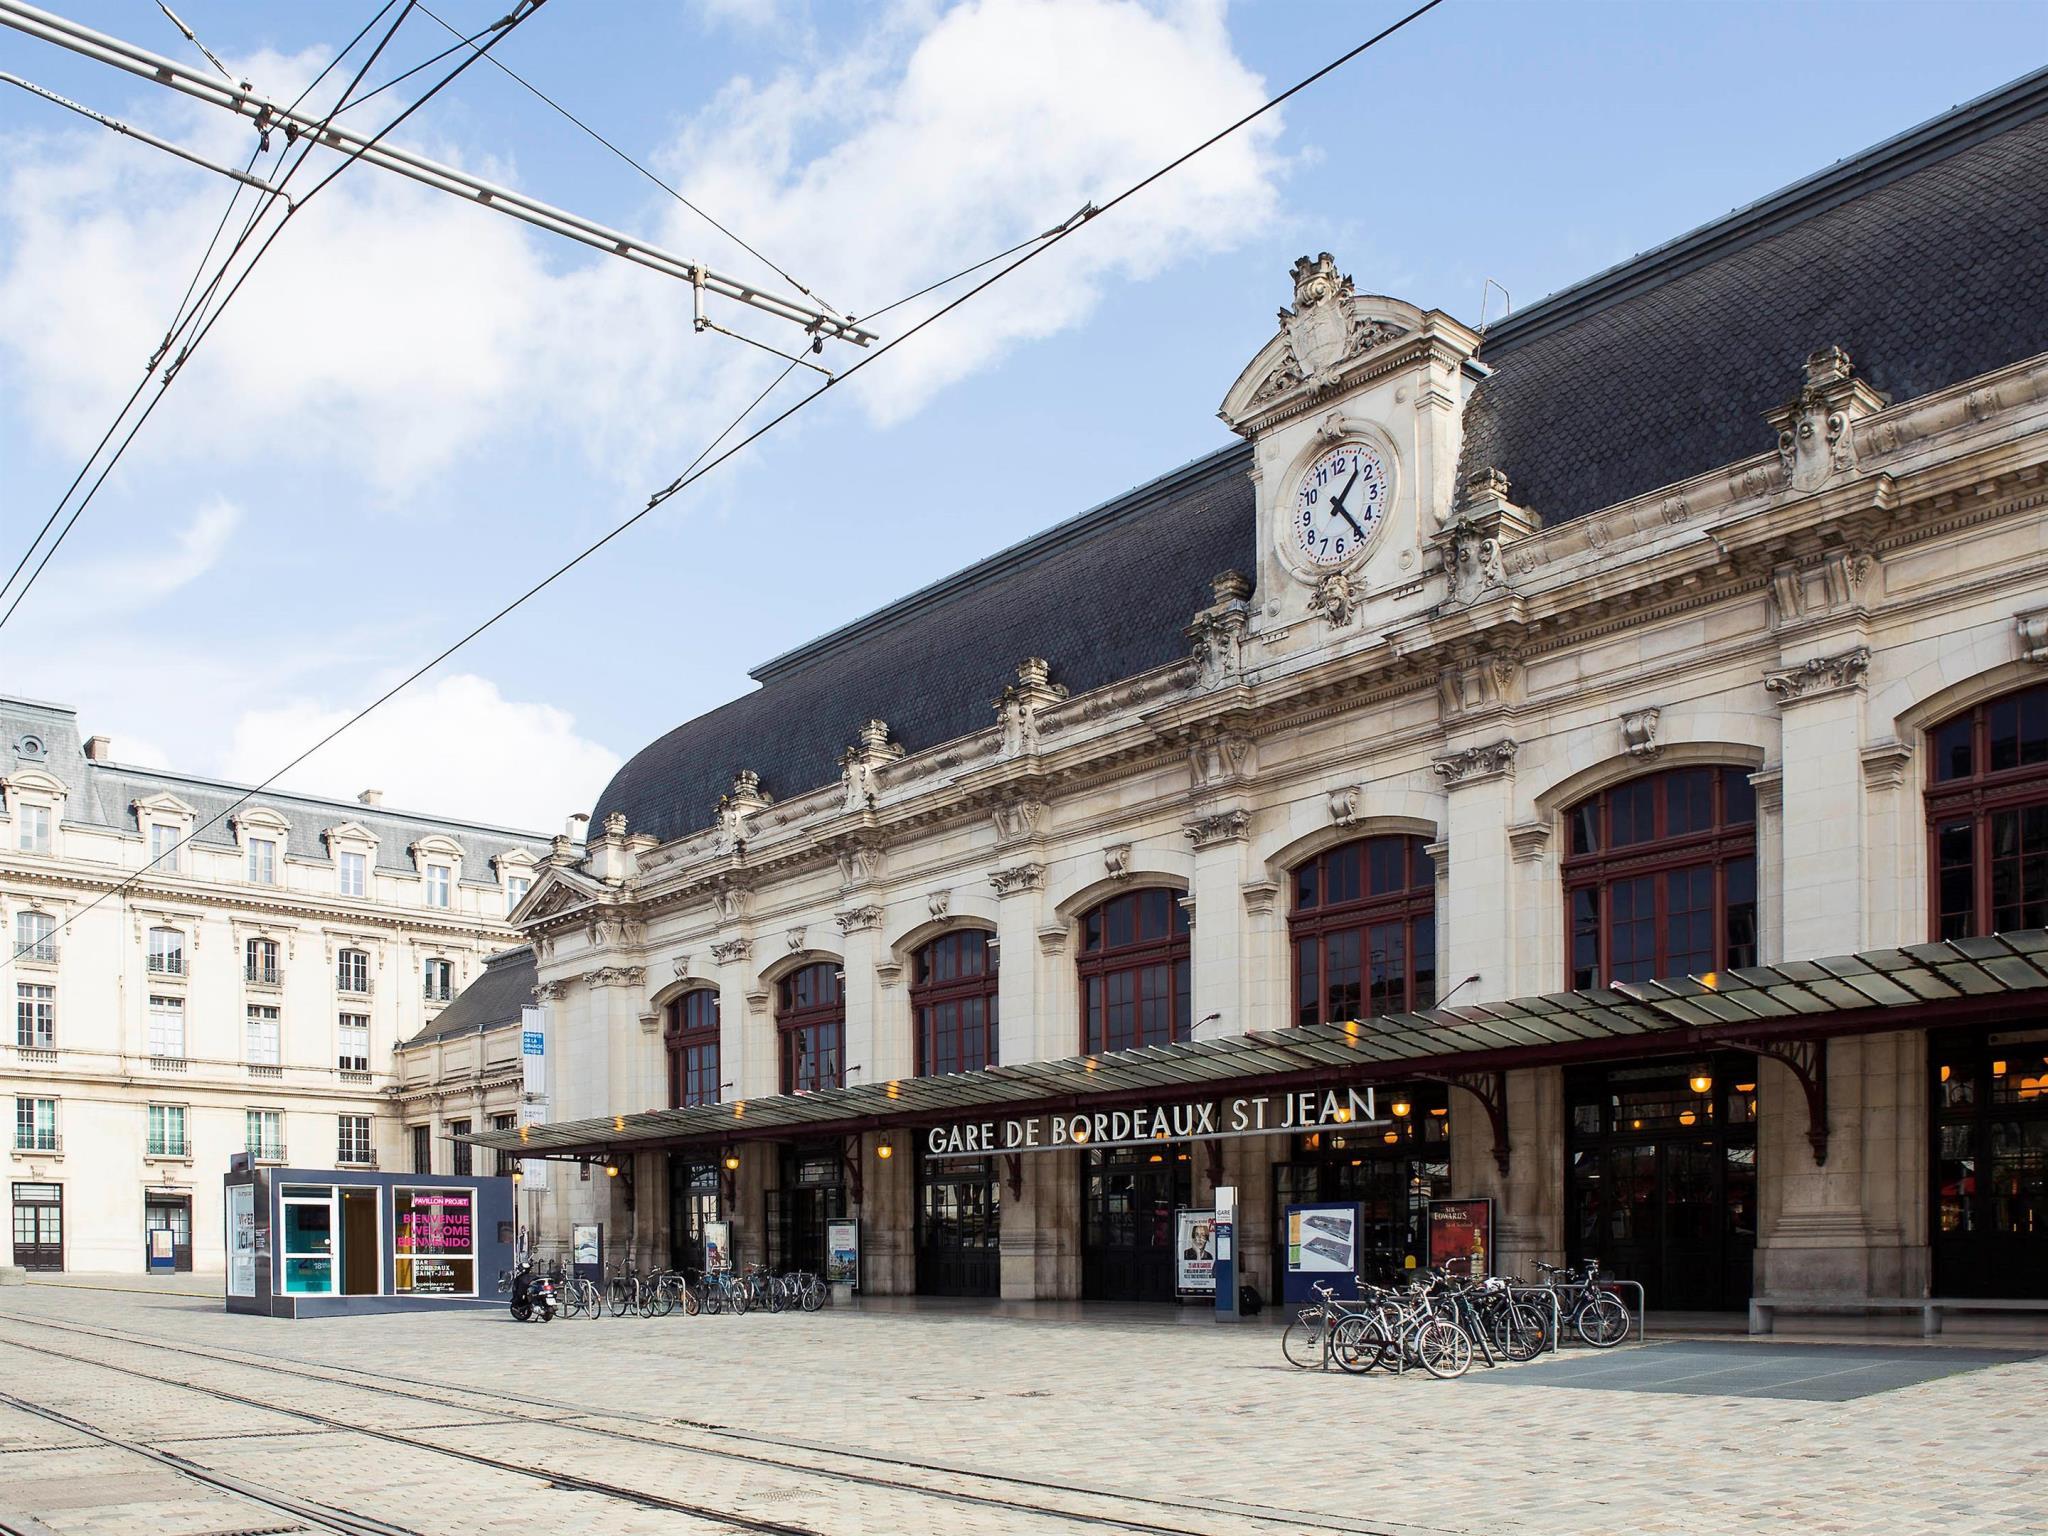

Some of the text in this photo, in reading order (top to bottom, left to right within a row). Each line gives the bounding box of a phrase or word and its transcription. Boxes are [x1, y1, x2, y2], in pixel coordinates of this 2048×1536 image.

[1331, 457, 1346, 476] 12
[1351, 455, 1359, 472] 1
[1316, 468, 1328, 486] 11
[1363, 464, 1373, 481] 2
[1304, 488, 1318, 506] 10
[1369, 484, 1378, 500] 3
[1303, 511, 1311, 527] 9
[1364, 505, 1372, 521] 4
[1307, 530, 1315, 545] 8
[1320, 538, 1328, 555] 7
[1335, 538, 1344, 554] 6
[928, 1087, 1375, 1153] GARE DE BORDEAUX ST JEAN
[415, 1197, 467, 1206] PAVILLON PROJET
[403, 1214, 470, 1224] BIENVENUE
[413, 1226, 470, 1235] WELCOME
[397, 1237, 470, 1247] BIENVENIDO
